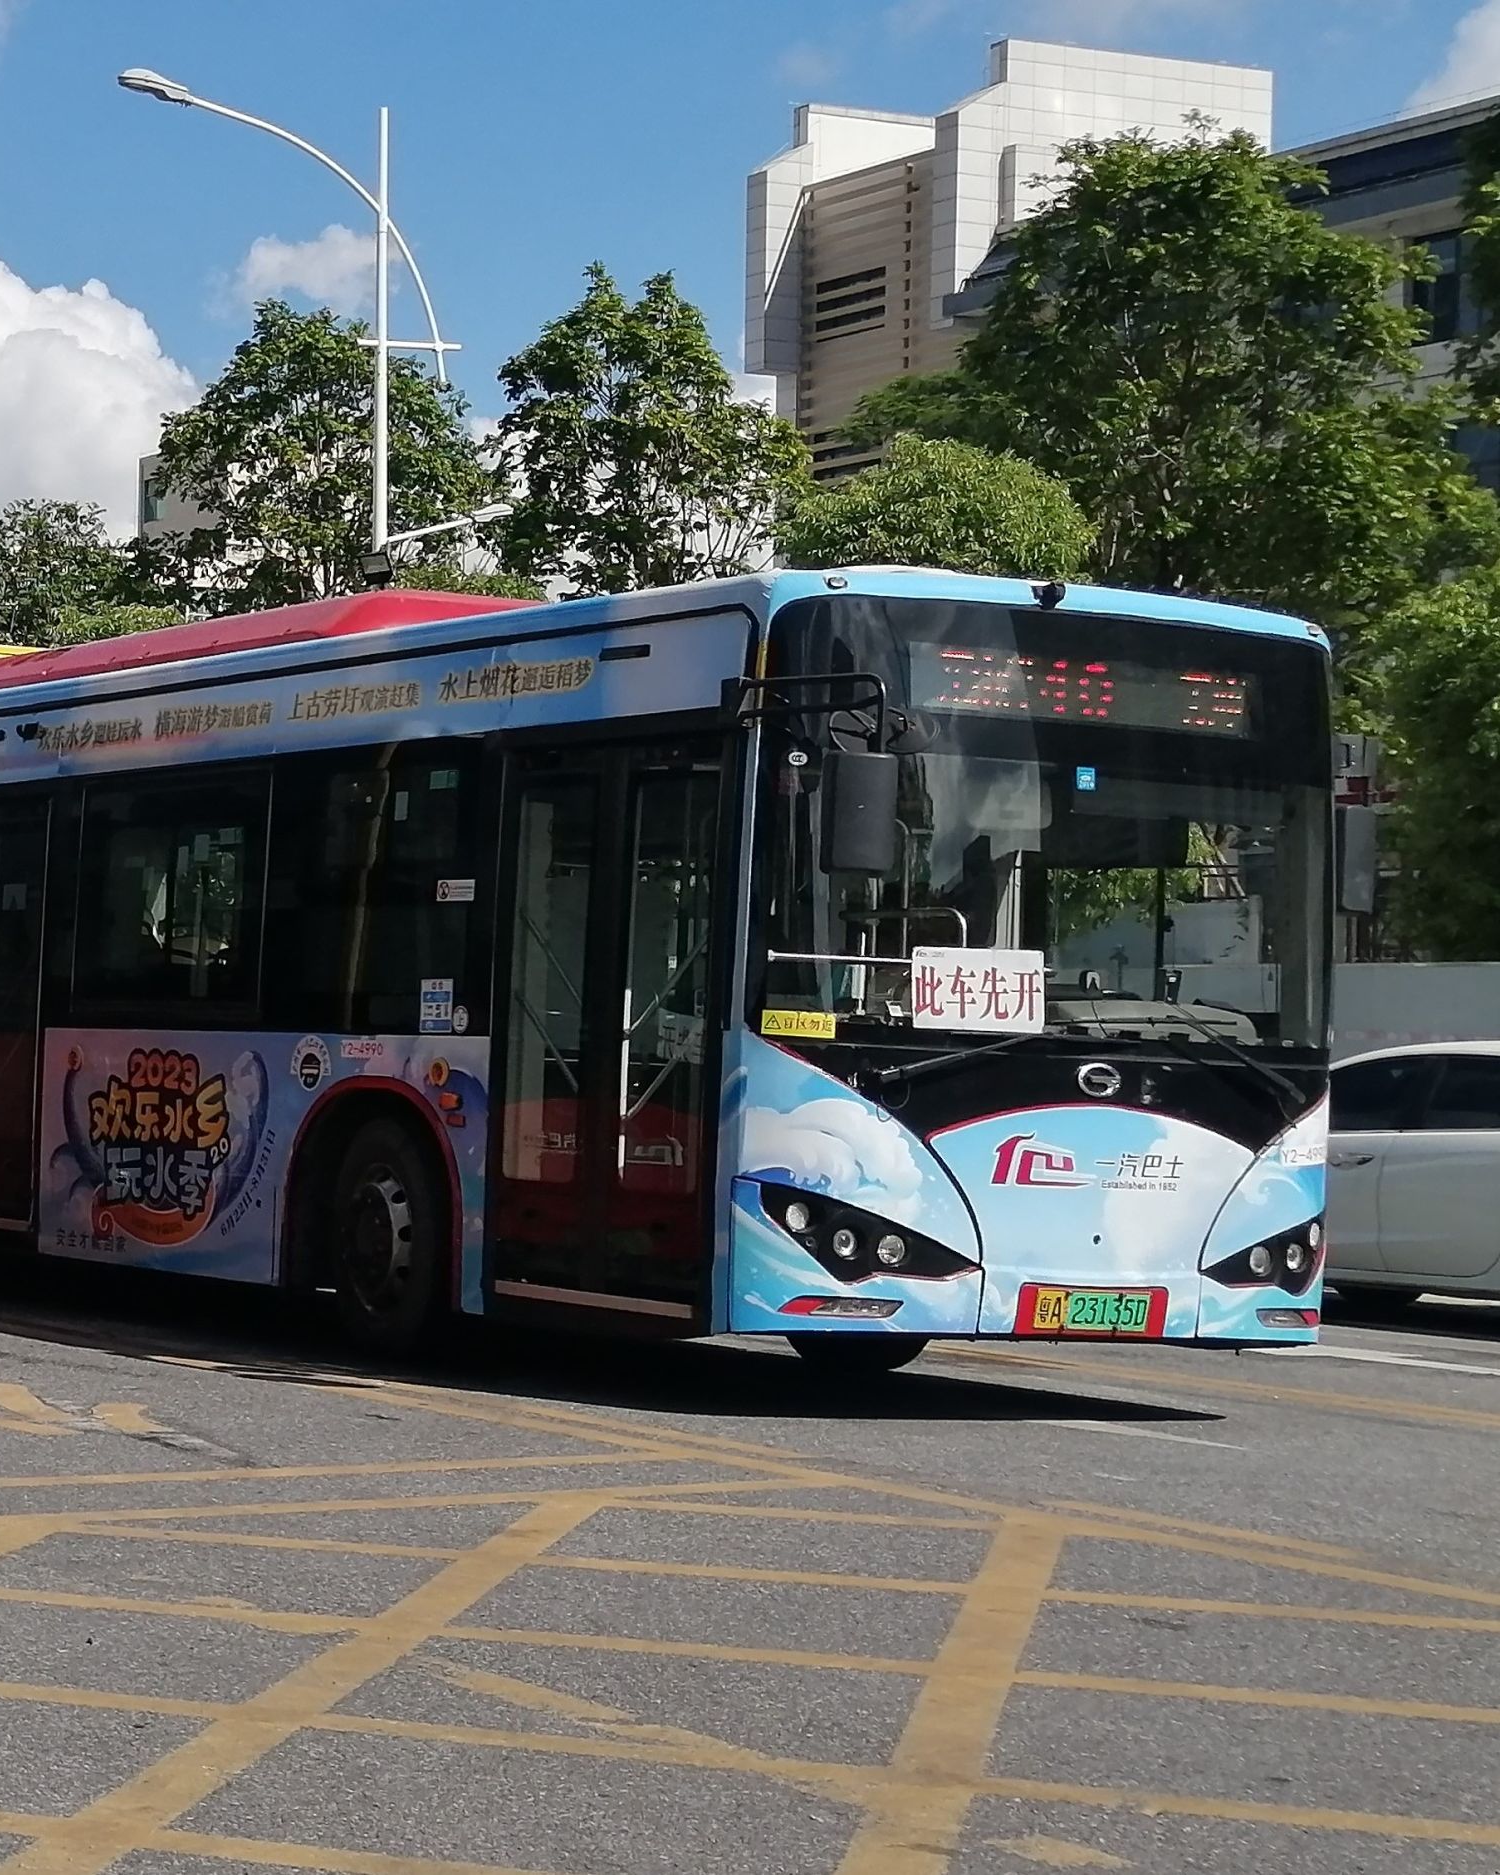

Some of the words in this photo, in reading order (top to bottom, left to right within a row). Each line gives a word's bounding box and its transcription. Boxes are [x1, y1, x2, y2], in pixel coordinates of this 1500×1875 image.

[288, 682, 421, 721] 上古劳圩观演赶集
[437, 658, 593, 702] 水上烟花邂逅稻梦
[915, 965, 1042, 1022] 此车先开
[130, 1052, 197, 1095] 2023
[91, 1079, 227, 1148] 欢乐水乡
[210, 1137, 229, 1165] 2.0
[1095, 1152, 1185, 1179] 一汽巴士
[106, 1146, 210, 1215] 玩水季
[1101, 1179, 1147, 1190] Established
[1148, 1181, 1156, 1190] in
